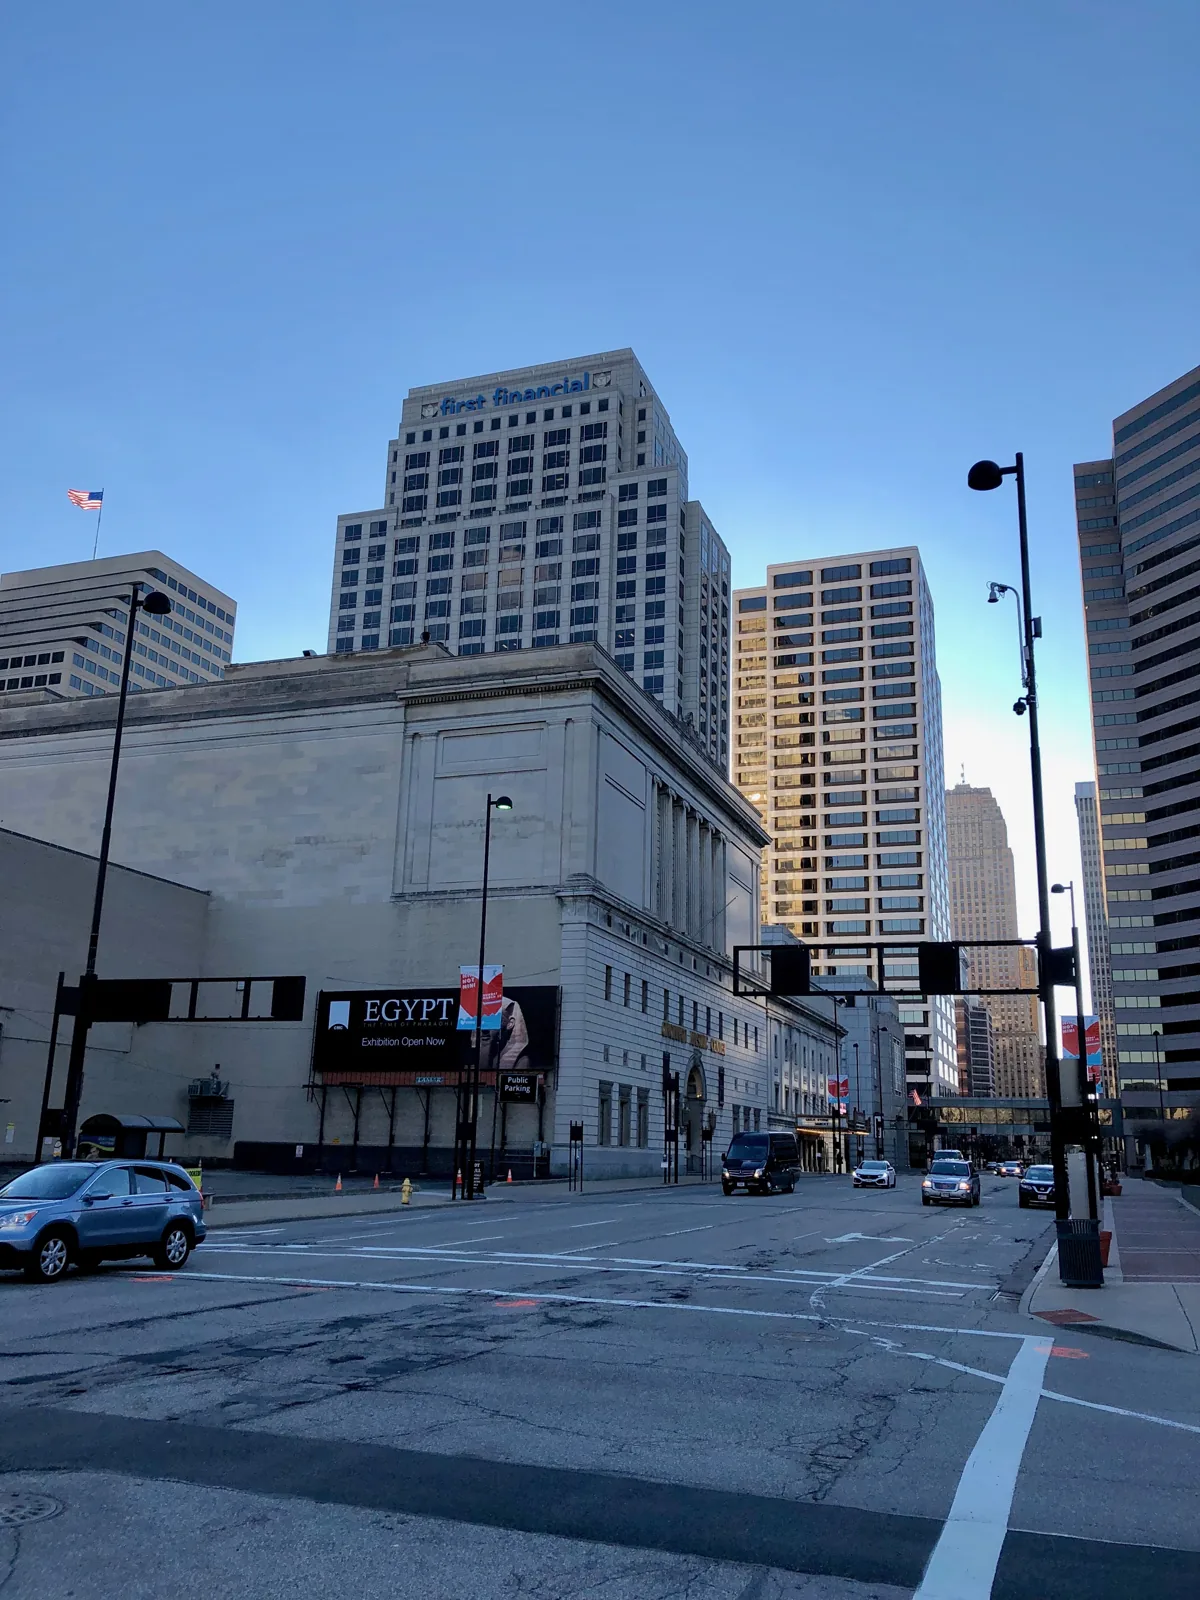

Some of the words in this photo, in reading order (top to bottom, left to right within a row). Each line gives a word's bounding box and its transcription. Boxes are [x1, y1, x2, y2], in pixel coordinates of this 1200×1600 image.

[440, 394, 487, 416] first
[493, 371, 590, 407] financial
[363, 998, 454, 1022] EGYPT
[361, 1037, 400, 1047] Exhibition
[401, 1037, 424, 1047] Open
[425, 1036, 446, 1046] Now
[507, 1076, 529, 1084] Public
[504, 1084, 531, 1094] Parking
